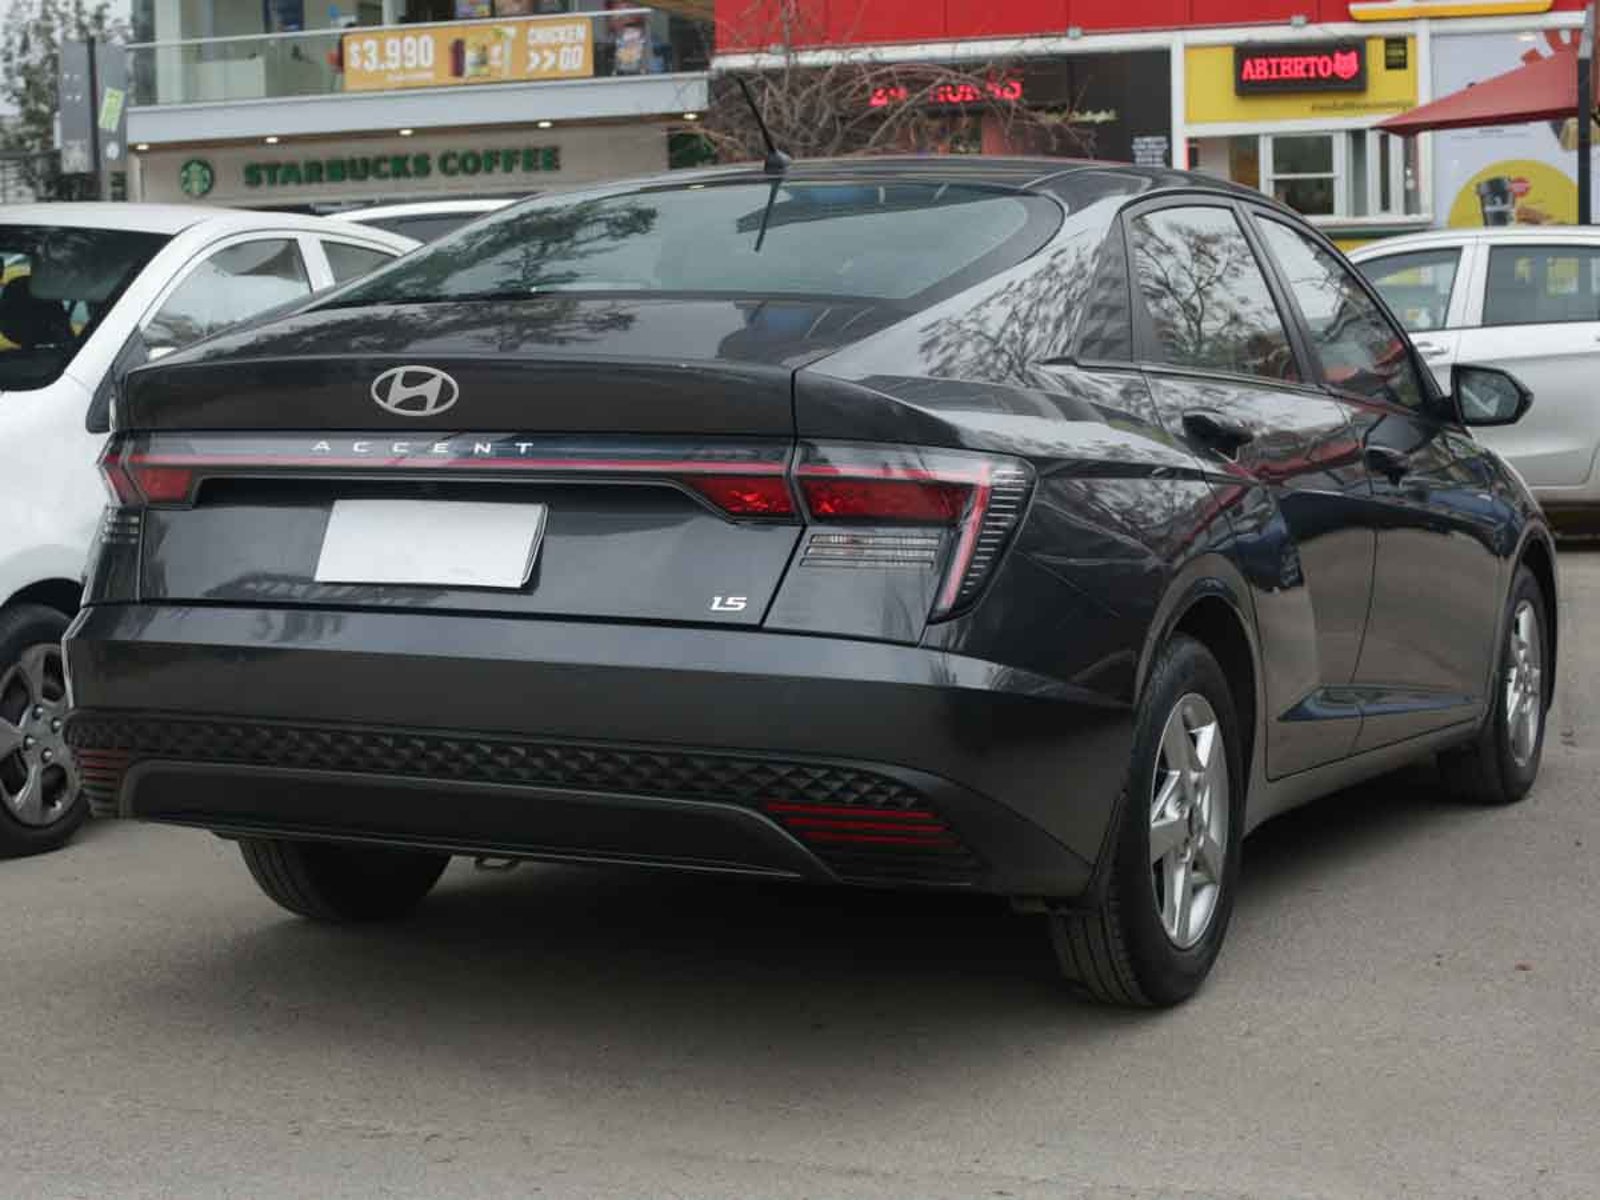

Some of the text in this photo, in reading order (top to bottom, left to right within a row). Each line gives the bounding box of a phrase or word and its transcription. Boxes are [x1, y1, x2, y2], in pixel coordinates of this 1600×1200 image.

[1242, 55, 1333, 81] ABIERTO
[244, 146, 562, 188] STARBUCKS COFFEE
[311, 439, 534, 455] ACCENT
